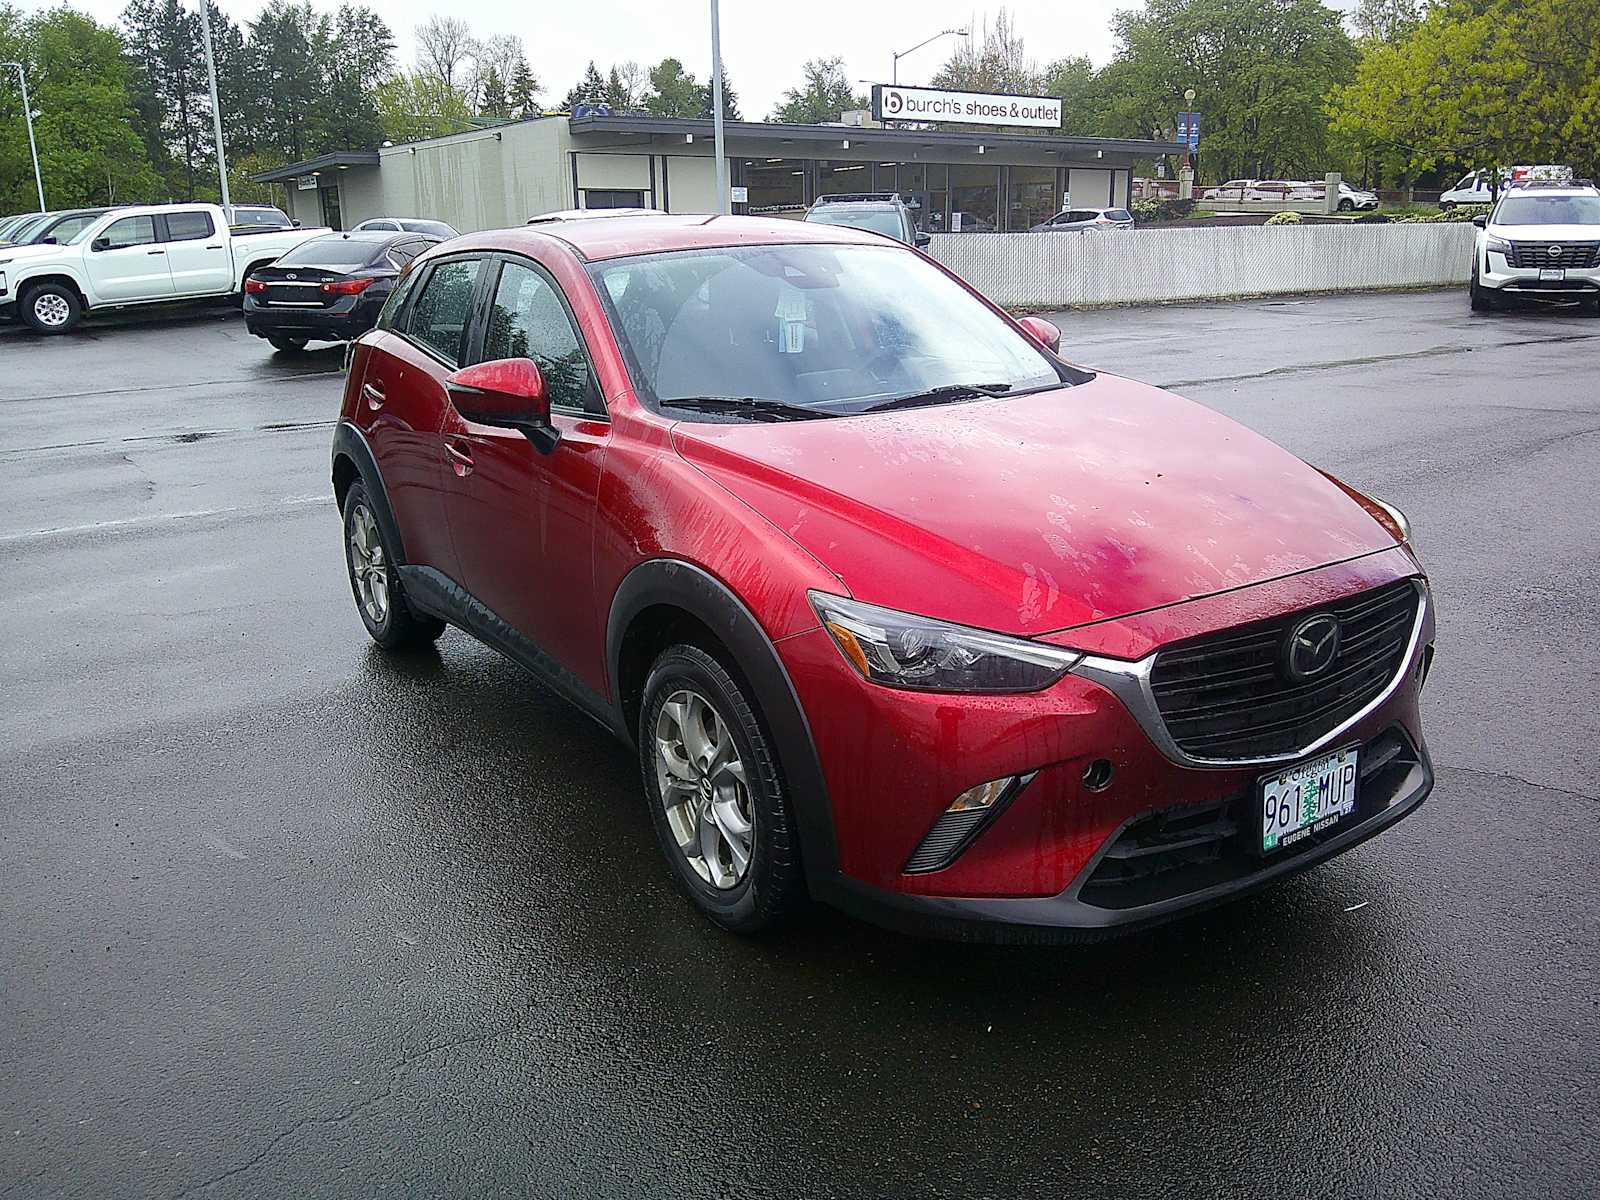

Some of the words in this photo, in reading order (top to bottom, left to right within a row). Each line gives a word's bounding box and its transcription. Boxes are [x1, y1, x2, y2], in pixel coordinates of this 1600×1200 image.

[906, 96, 961, 114] burch's
[966, 101, 1007, 118] shoes
[1009, 103, 1019, 118] &
[1021, 105, 1059, 121] outlet
[1265, 784, 1301, 834] 961
[1317, 764, 1354, 813] MUP
[1282, 827, 1311, 847] EUGENE
[1313, 813, 1339, 833] NISSAN
